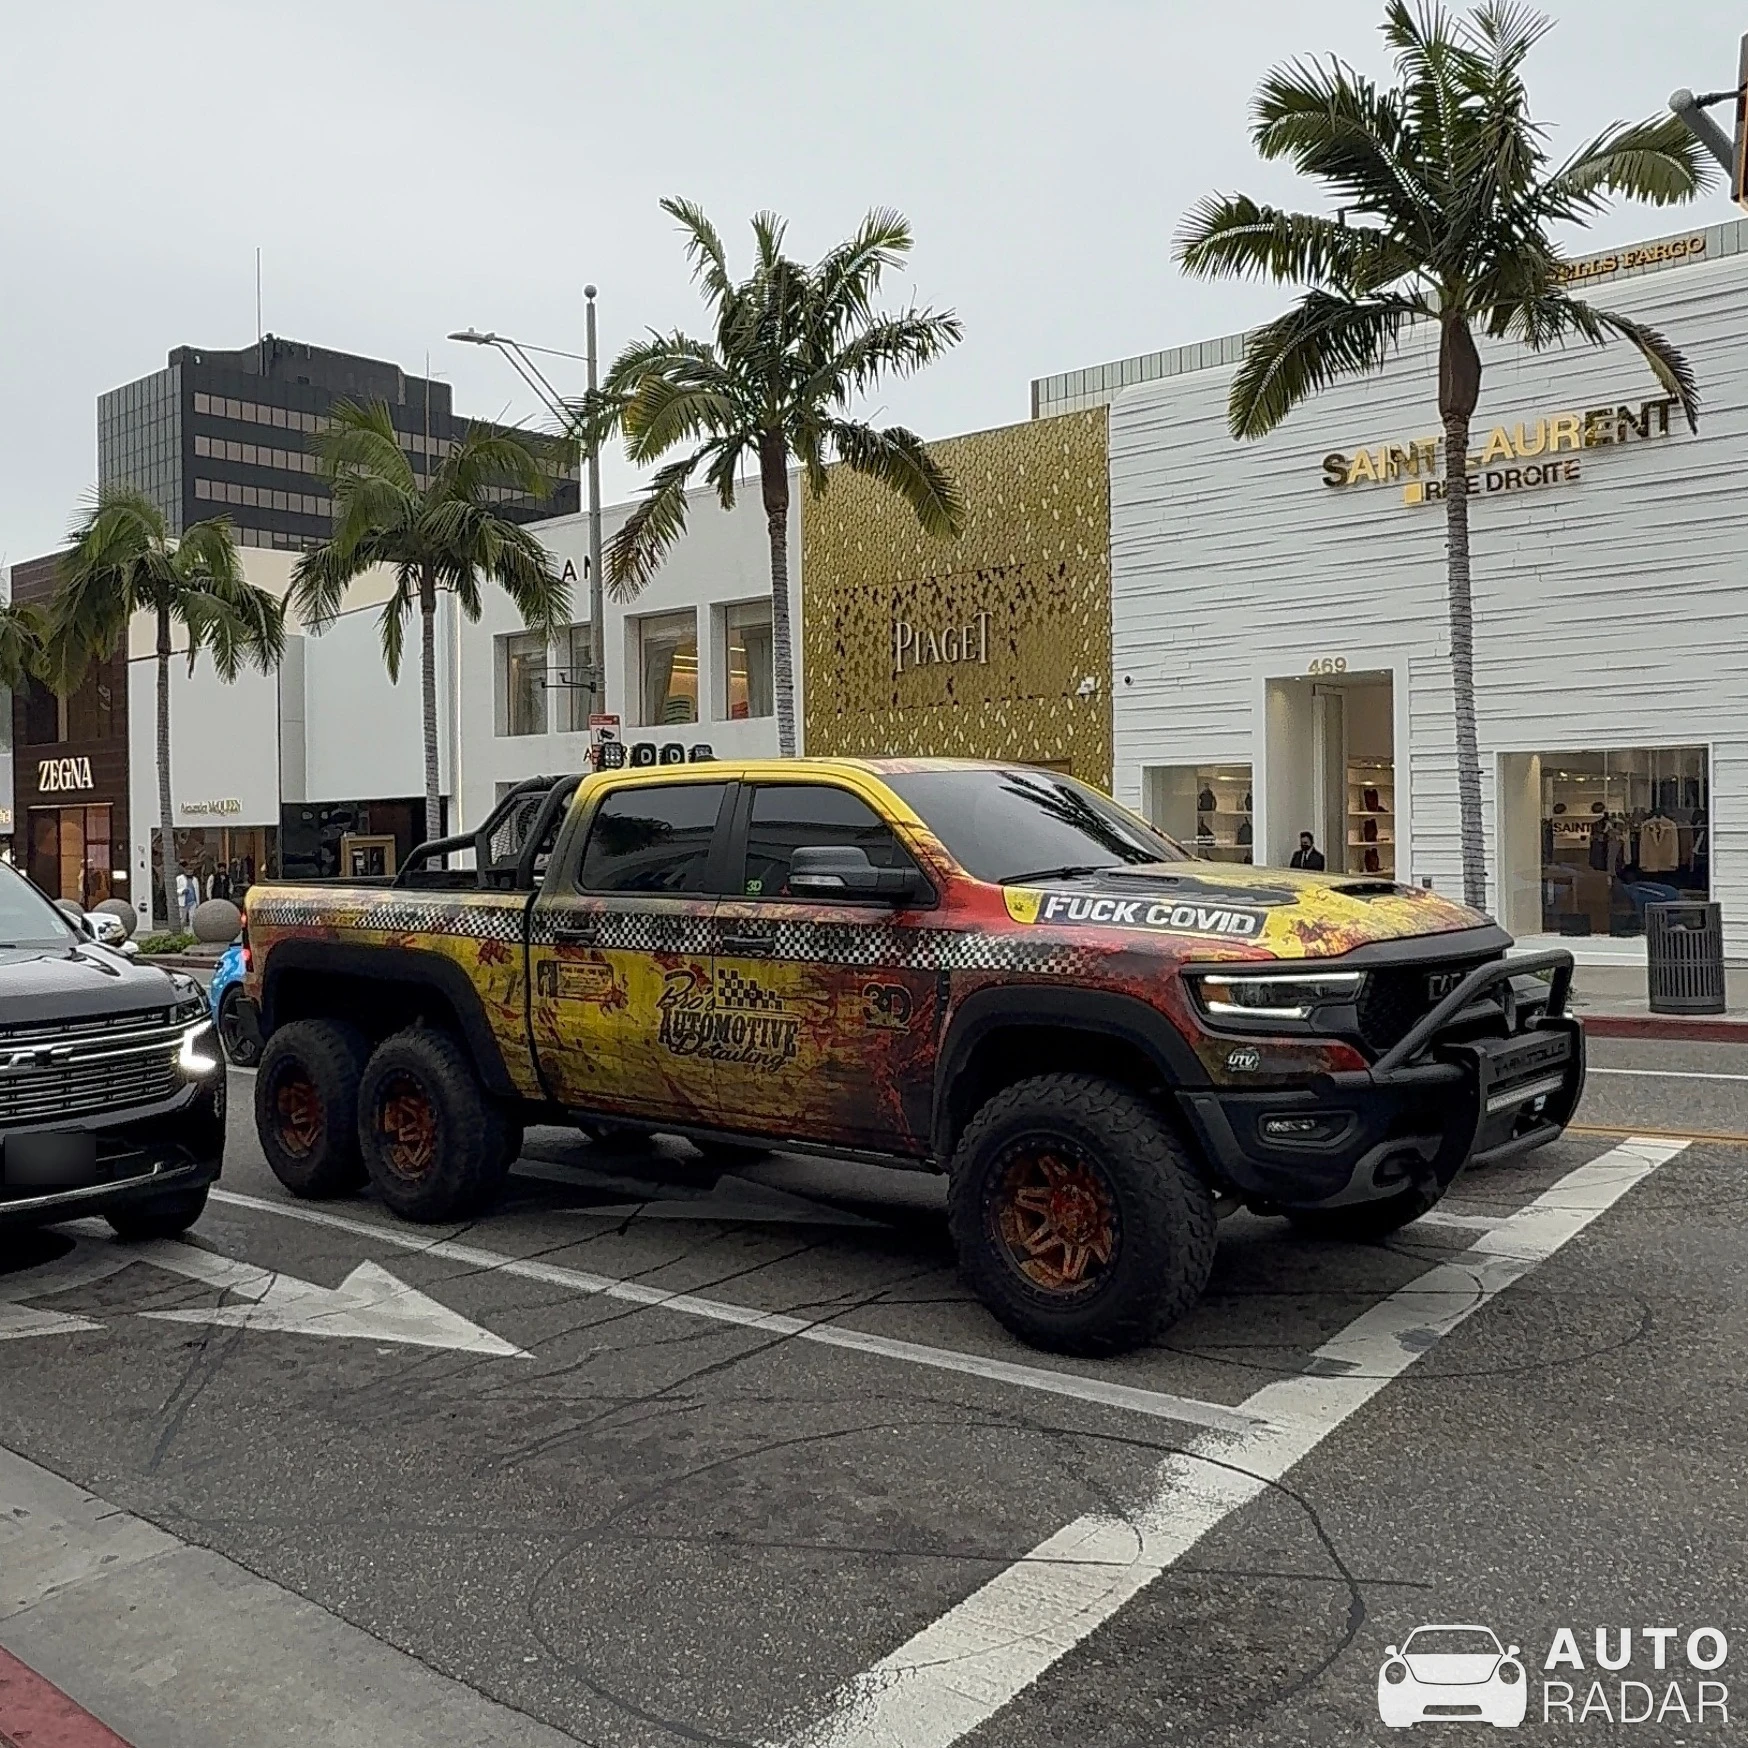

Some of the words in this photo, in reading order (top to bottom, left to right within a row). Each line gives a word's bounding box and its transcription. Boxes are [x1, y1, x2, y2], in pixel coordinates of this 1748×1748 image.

[1548, 254, 1618, 281] ELLS
[1623, 236, 1707, 269] FARGO
[1322, 434, 1443, 487] SAINT
[1425, 472, 1480, 502] RE
[1486, 459, 1580, 492] DROITE
[895, 611, 993, 673] PIAGET
[1308, 656, 1347, 675] 469
[38, 757, 94, 791] ZEGNA
[1554, 822, 1590, 833] SAINT
[1044, 896, 1140, 923] FUCK
[1146, 904, 1256, 935] COVID
[658, 1008, 799, 1057] AUTOMOTIVE
[669, 1032, 788, 1073] Detailing
[1229, 1055, 1256, 1066] UTV
